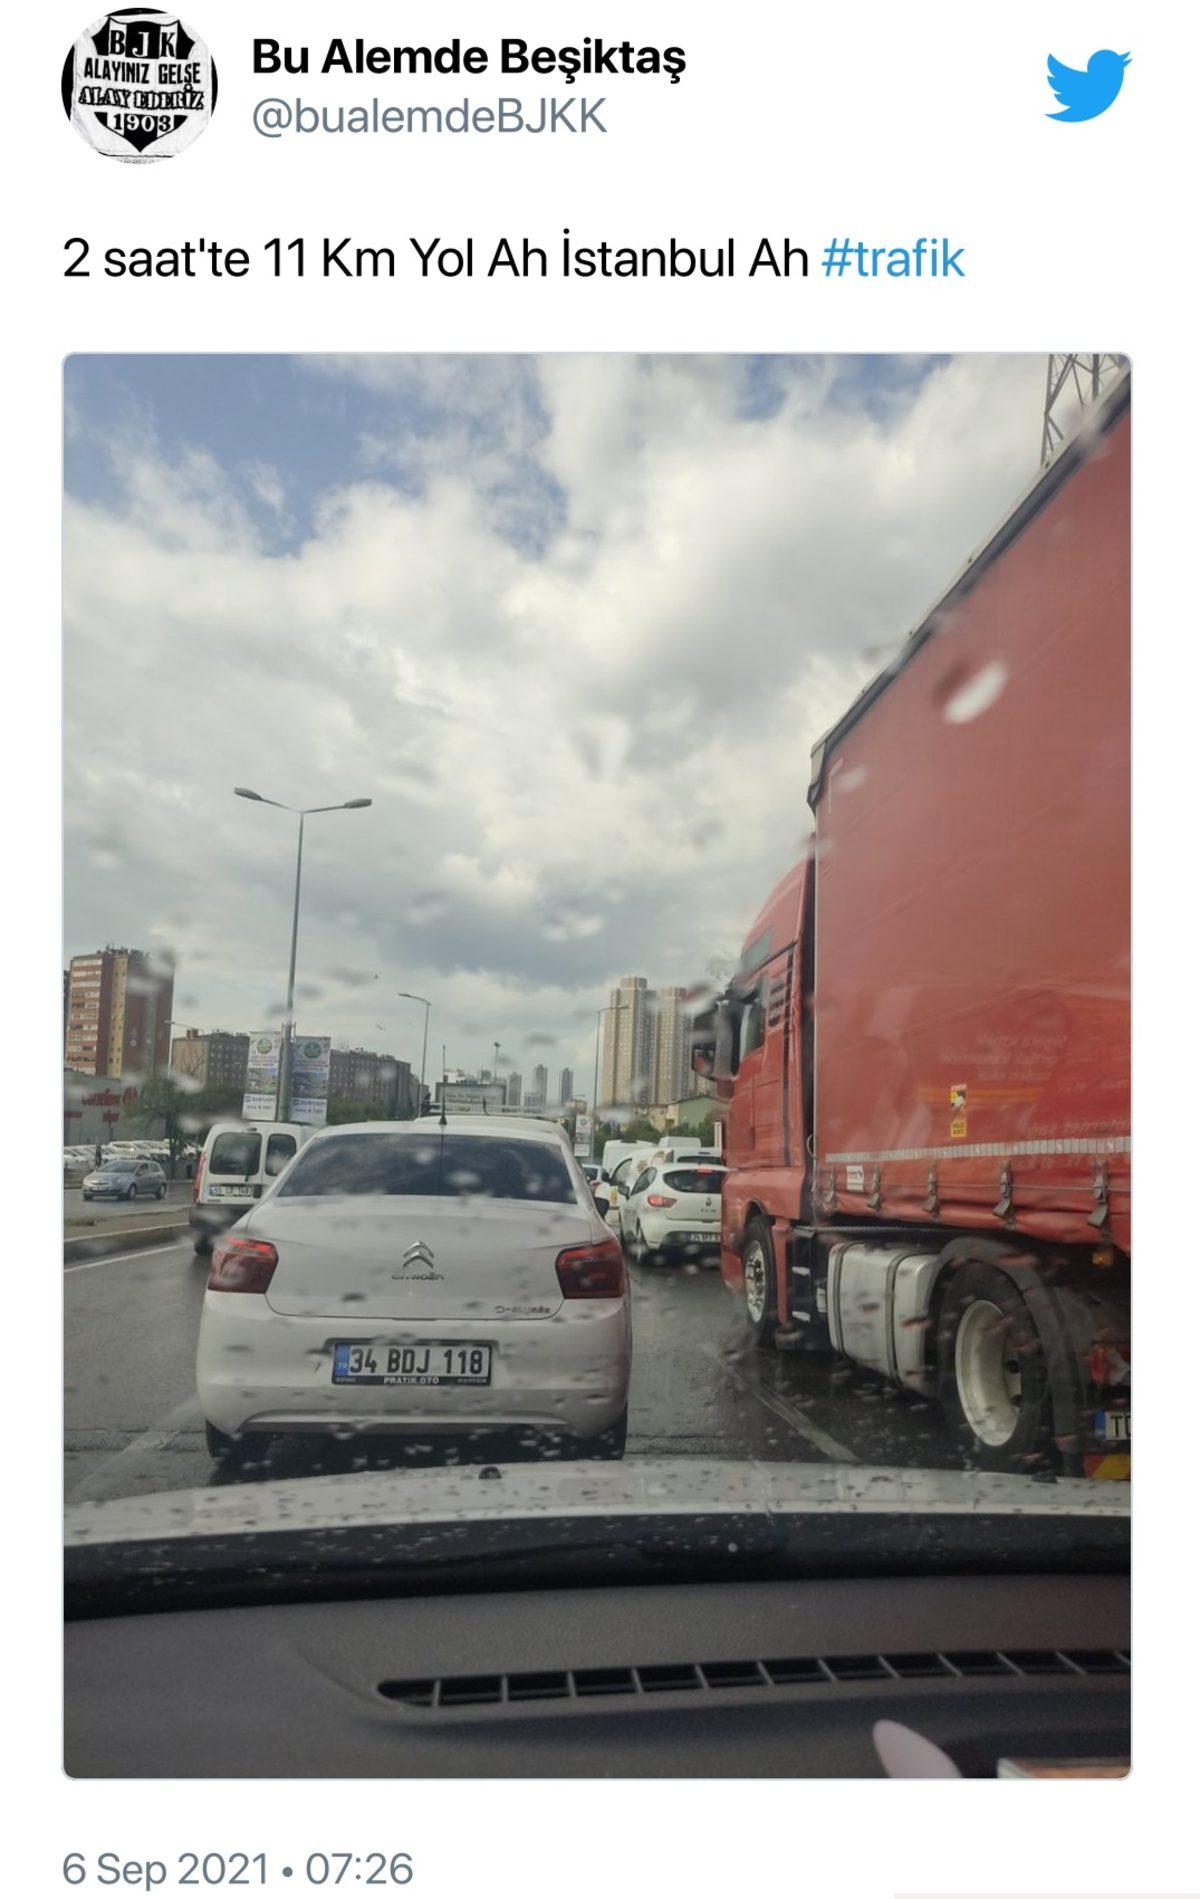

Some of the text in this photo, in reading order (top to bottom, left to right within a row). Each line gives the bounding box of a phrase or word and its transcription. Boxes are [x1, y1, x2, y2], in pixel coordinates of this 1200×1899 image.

[349, 1348, 377, 1373] 34
[387, 1348, 430, 1374] BDJ
[443, 1349, 483, 1375] 118
